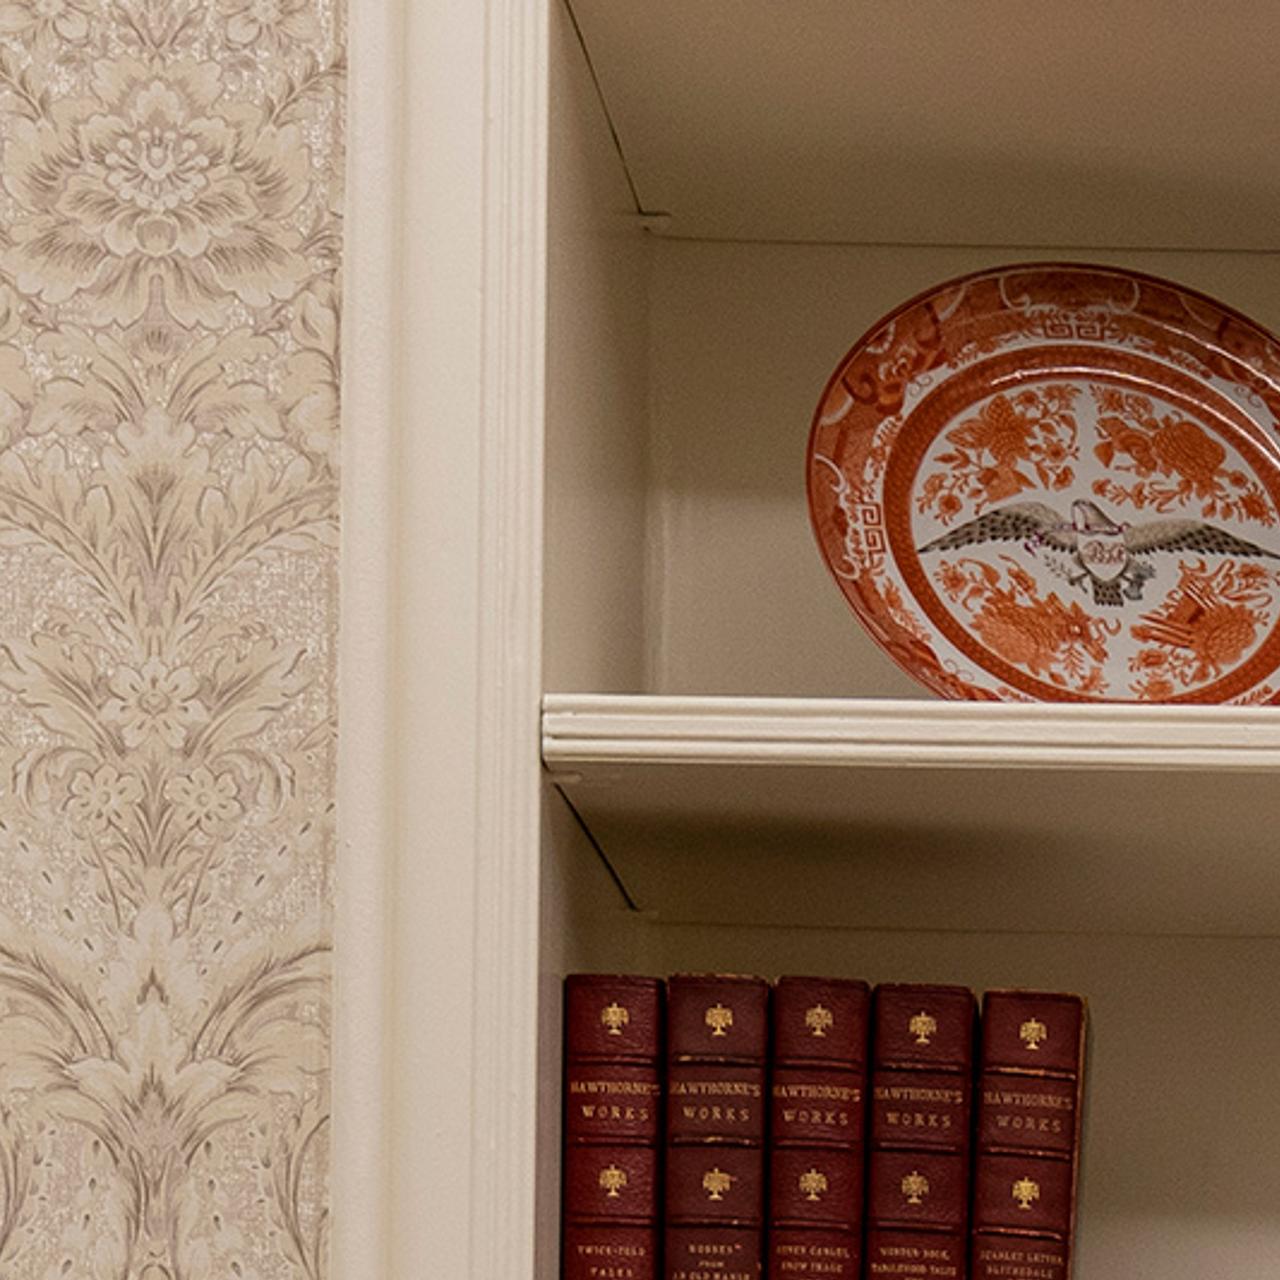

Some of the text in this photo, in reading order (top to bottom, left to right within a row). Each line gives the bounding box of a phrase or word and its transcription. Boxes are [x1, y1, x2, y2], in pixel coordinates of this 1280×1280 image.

[581, 1105, 649, 1122] WORKS
[682, 1106, 750, 1124] WORKS
[782, 1109, 849, 1128] WORKS
[885, 1111, 951, 1129] WORKS
[995, 1114, 1061, 1135] WORKS
